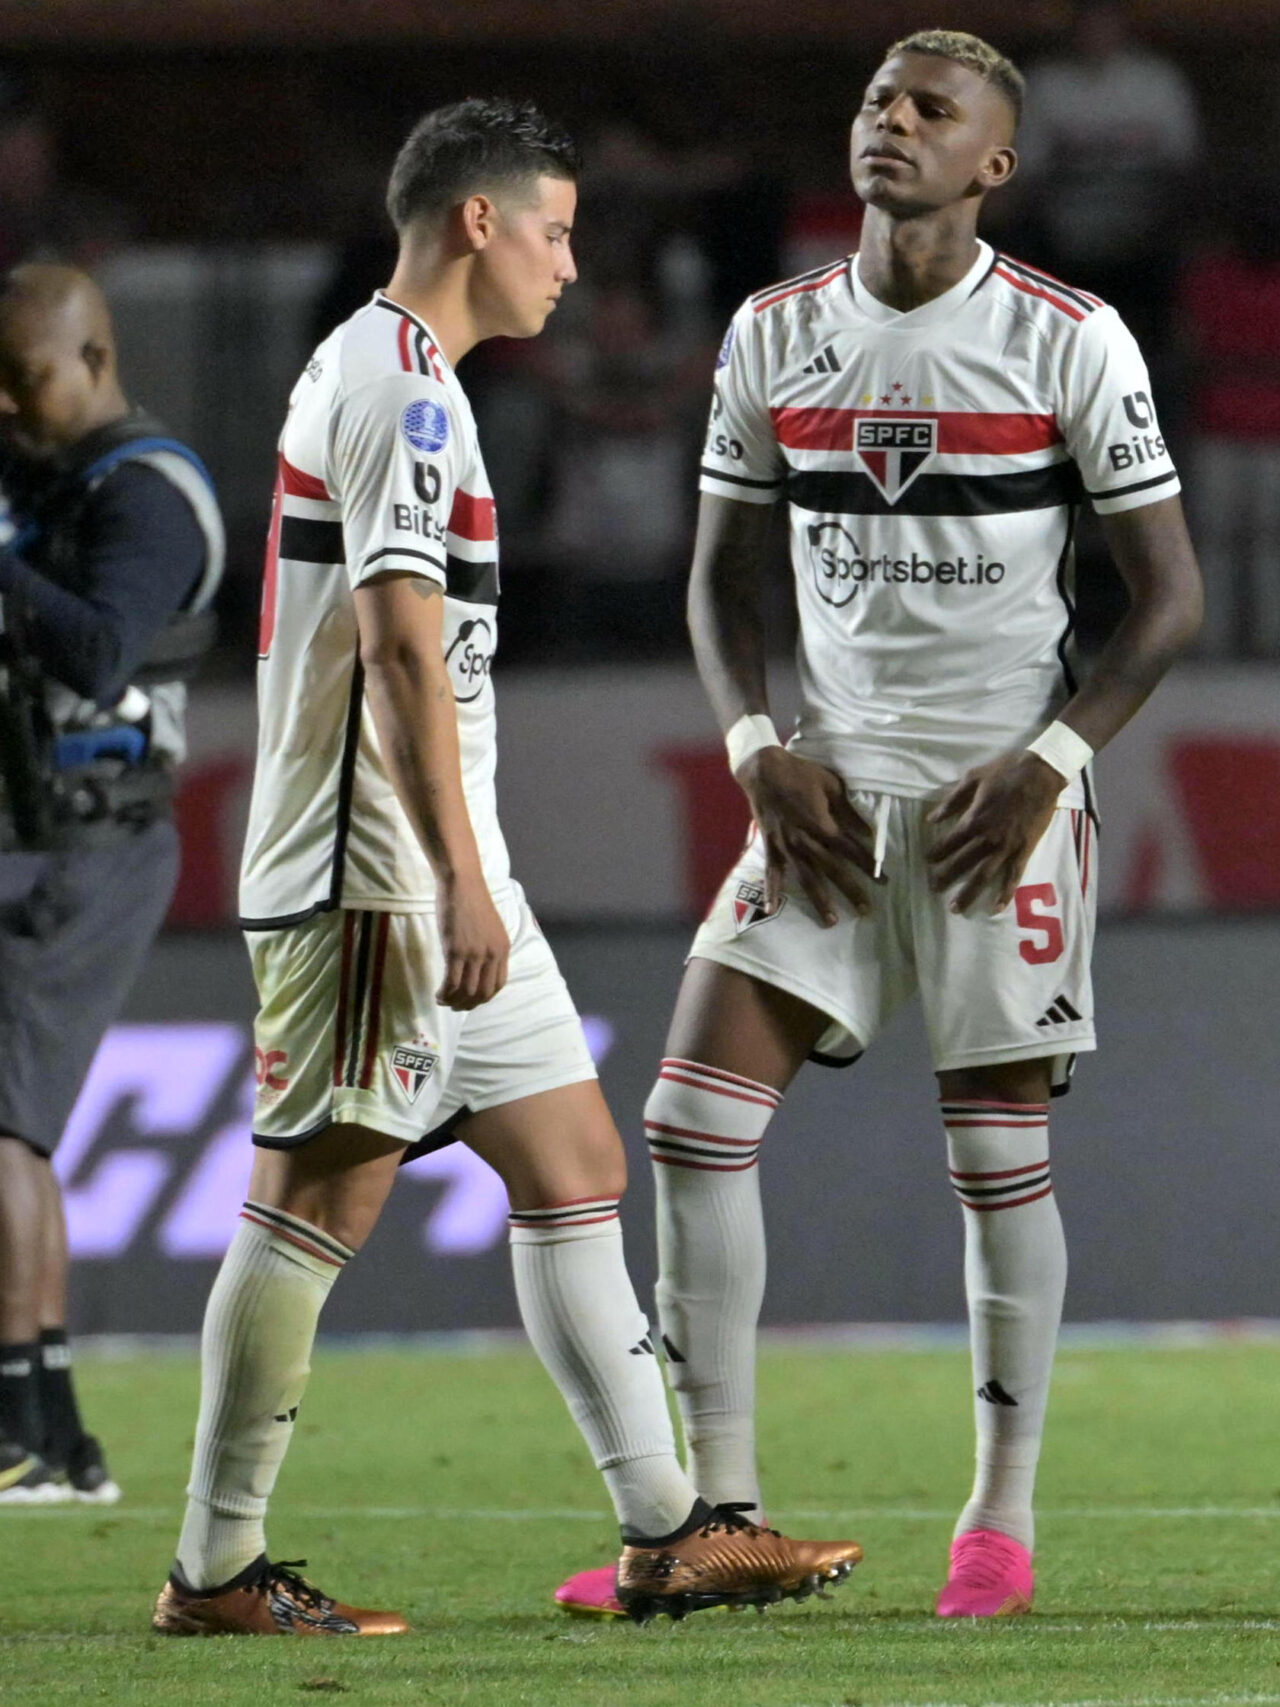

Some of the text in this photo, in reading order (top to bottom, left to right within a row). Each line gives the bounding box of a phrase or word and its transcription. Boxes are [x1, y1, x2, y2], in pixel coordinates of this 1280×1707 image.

[859, 425, 930, 445] SPFC
[821, 548, 1005, 587] Sportsbet.io
[395, 1052, 433, 1073] SPFC
